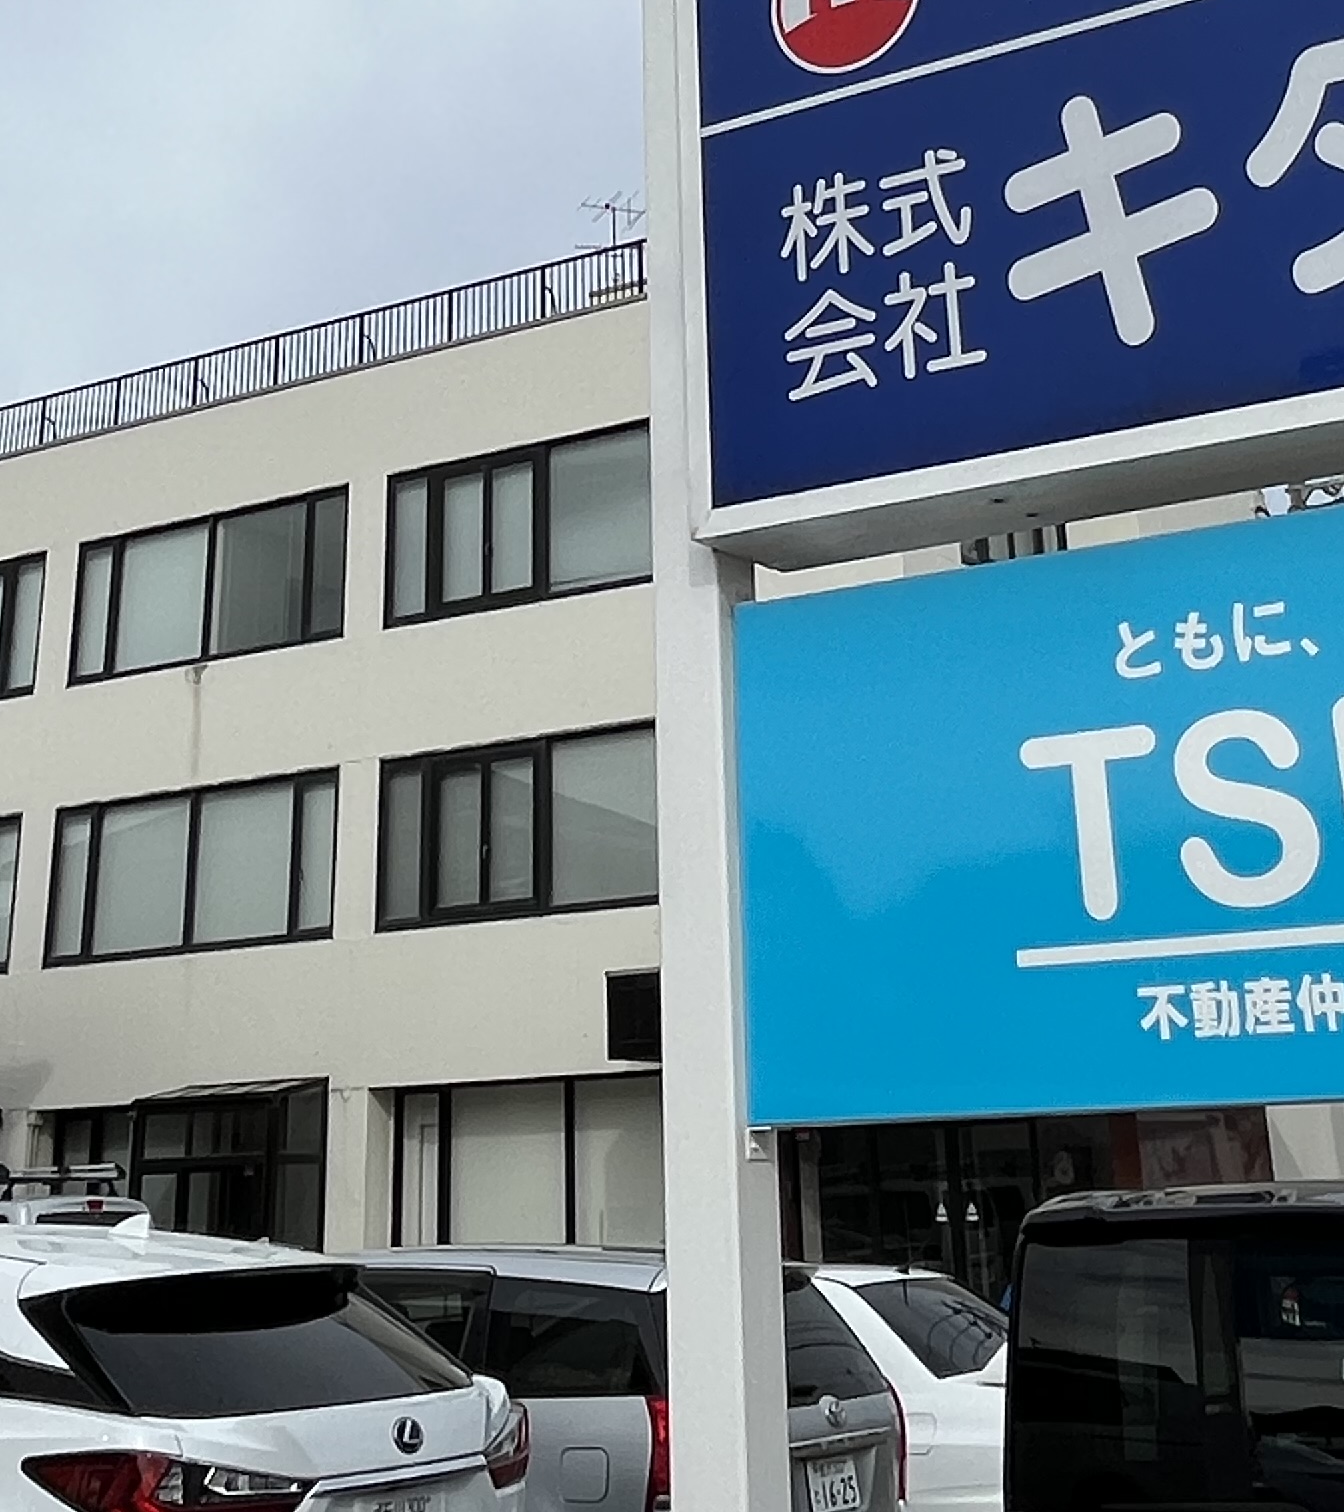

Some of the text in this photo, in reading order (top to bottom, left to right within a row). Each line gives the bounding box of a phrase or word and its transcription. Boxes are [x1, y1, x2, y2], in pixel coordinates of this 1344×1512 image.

[780, 148, 972, 282] 株式
[784, 261, 988, 402] 会社
[822, 1475, 856, 1508] 16-25
